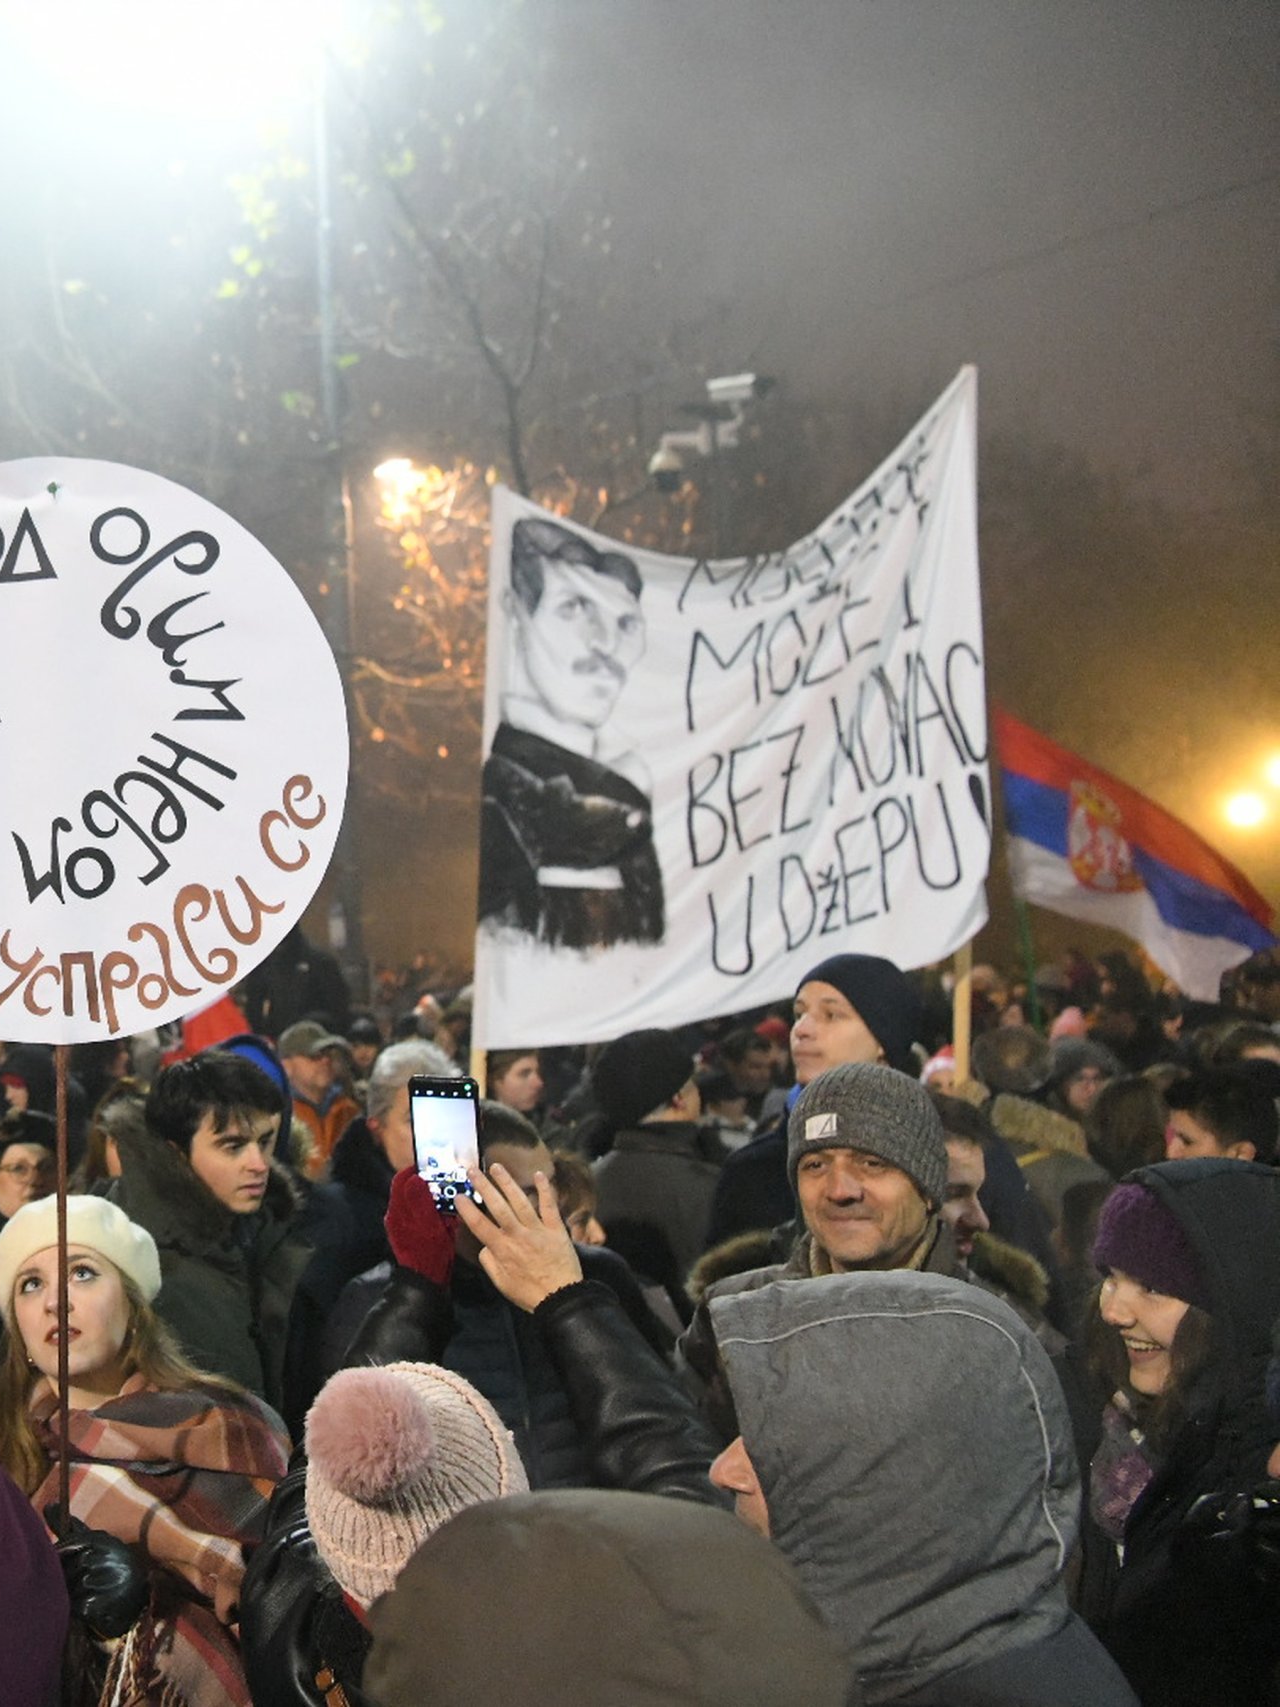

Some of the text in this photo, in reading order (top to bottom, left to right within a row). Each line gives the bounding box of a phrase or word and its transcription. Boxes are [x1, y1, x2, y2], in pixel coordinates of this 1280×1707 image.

[90, 506, 246, 721] овим
[259, 774, 326, 872] се
[687, 723, 812, 868] BEZ
[707, 874, 754, 975] U
